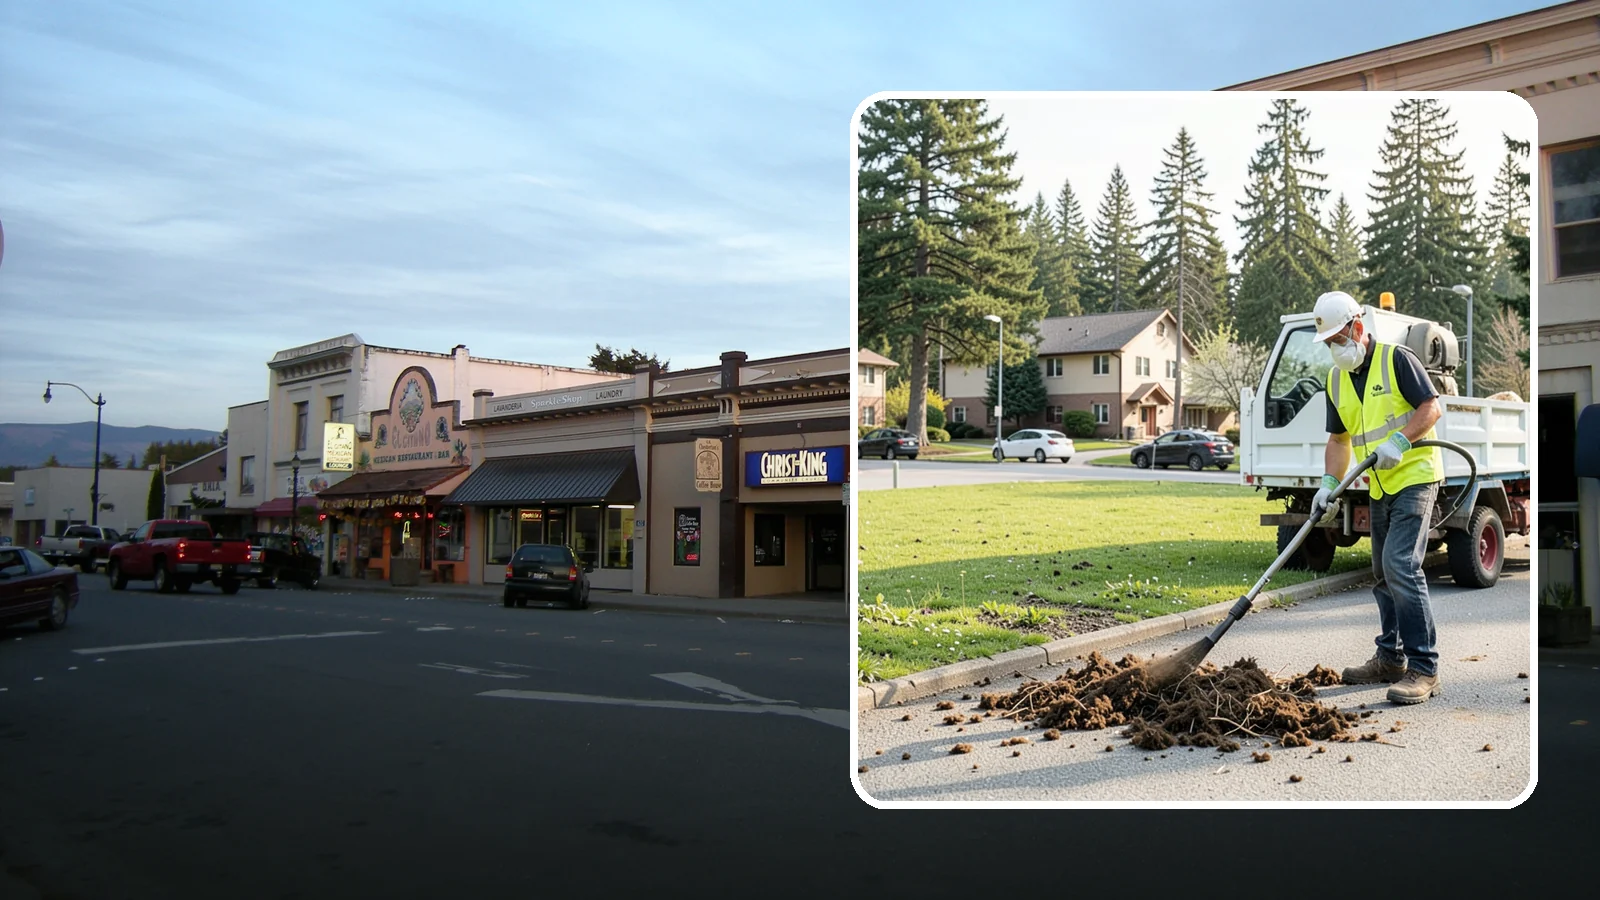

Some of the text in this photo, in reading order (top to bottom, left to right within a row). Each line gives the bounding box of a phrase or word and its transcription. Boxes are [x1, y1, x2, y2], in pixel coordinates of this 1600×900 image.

[530, 394, 582, 409] Sparkle Shop
[596, 389, 623, 400] LAUNDRY
[494, 402, 522, 412] LAVANDERIA
[373, 455, 396, 464] MEXICAN
[397, 451, 433, 462] RESTAURANT
[438, 450, 450, 458] BAR
[761, 452, 797, 478] CHRIST
[799, 449, 827, 476] KING
